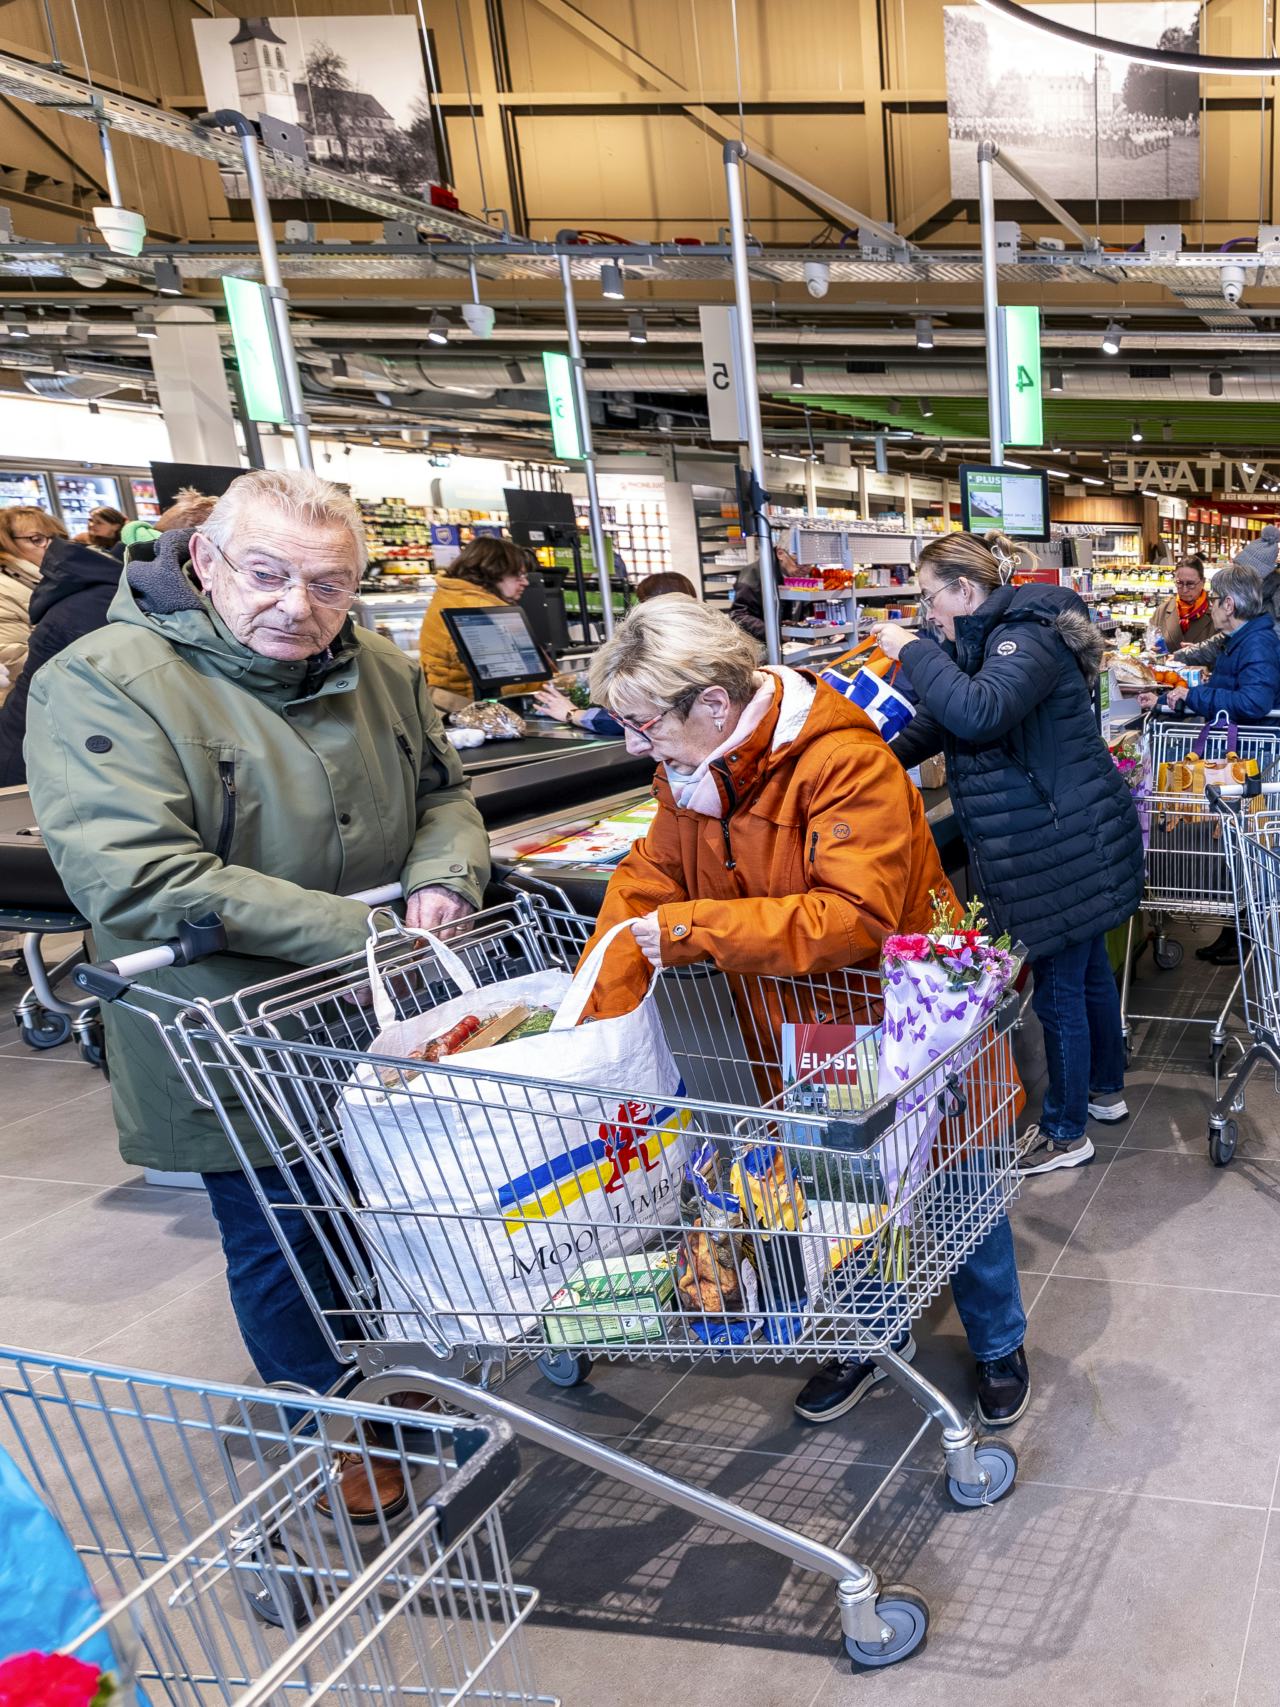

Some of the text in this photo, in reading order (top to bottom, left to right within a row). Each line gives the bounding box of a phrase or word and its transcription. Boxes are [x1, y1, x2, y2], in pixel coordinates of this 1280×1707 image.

[975, 475, 1001, 485] PLUS
[801, 1052, 878, 1071] EIJSDE
[614, 1163, 688, 1225] LIMBU
